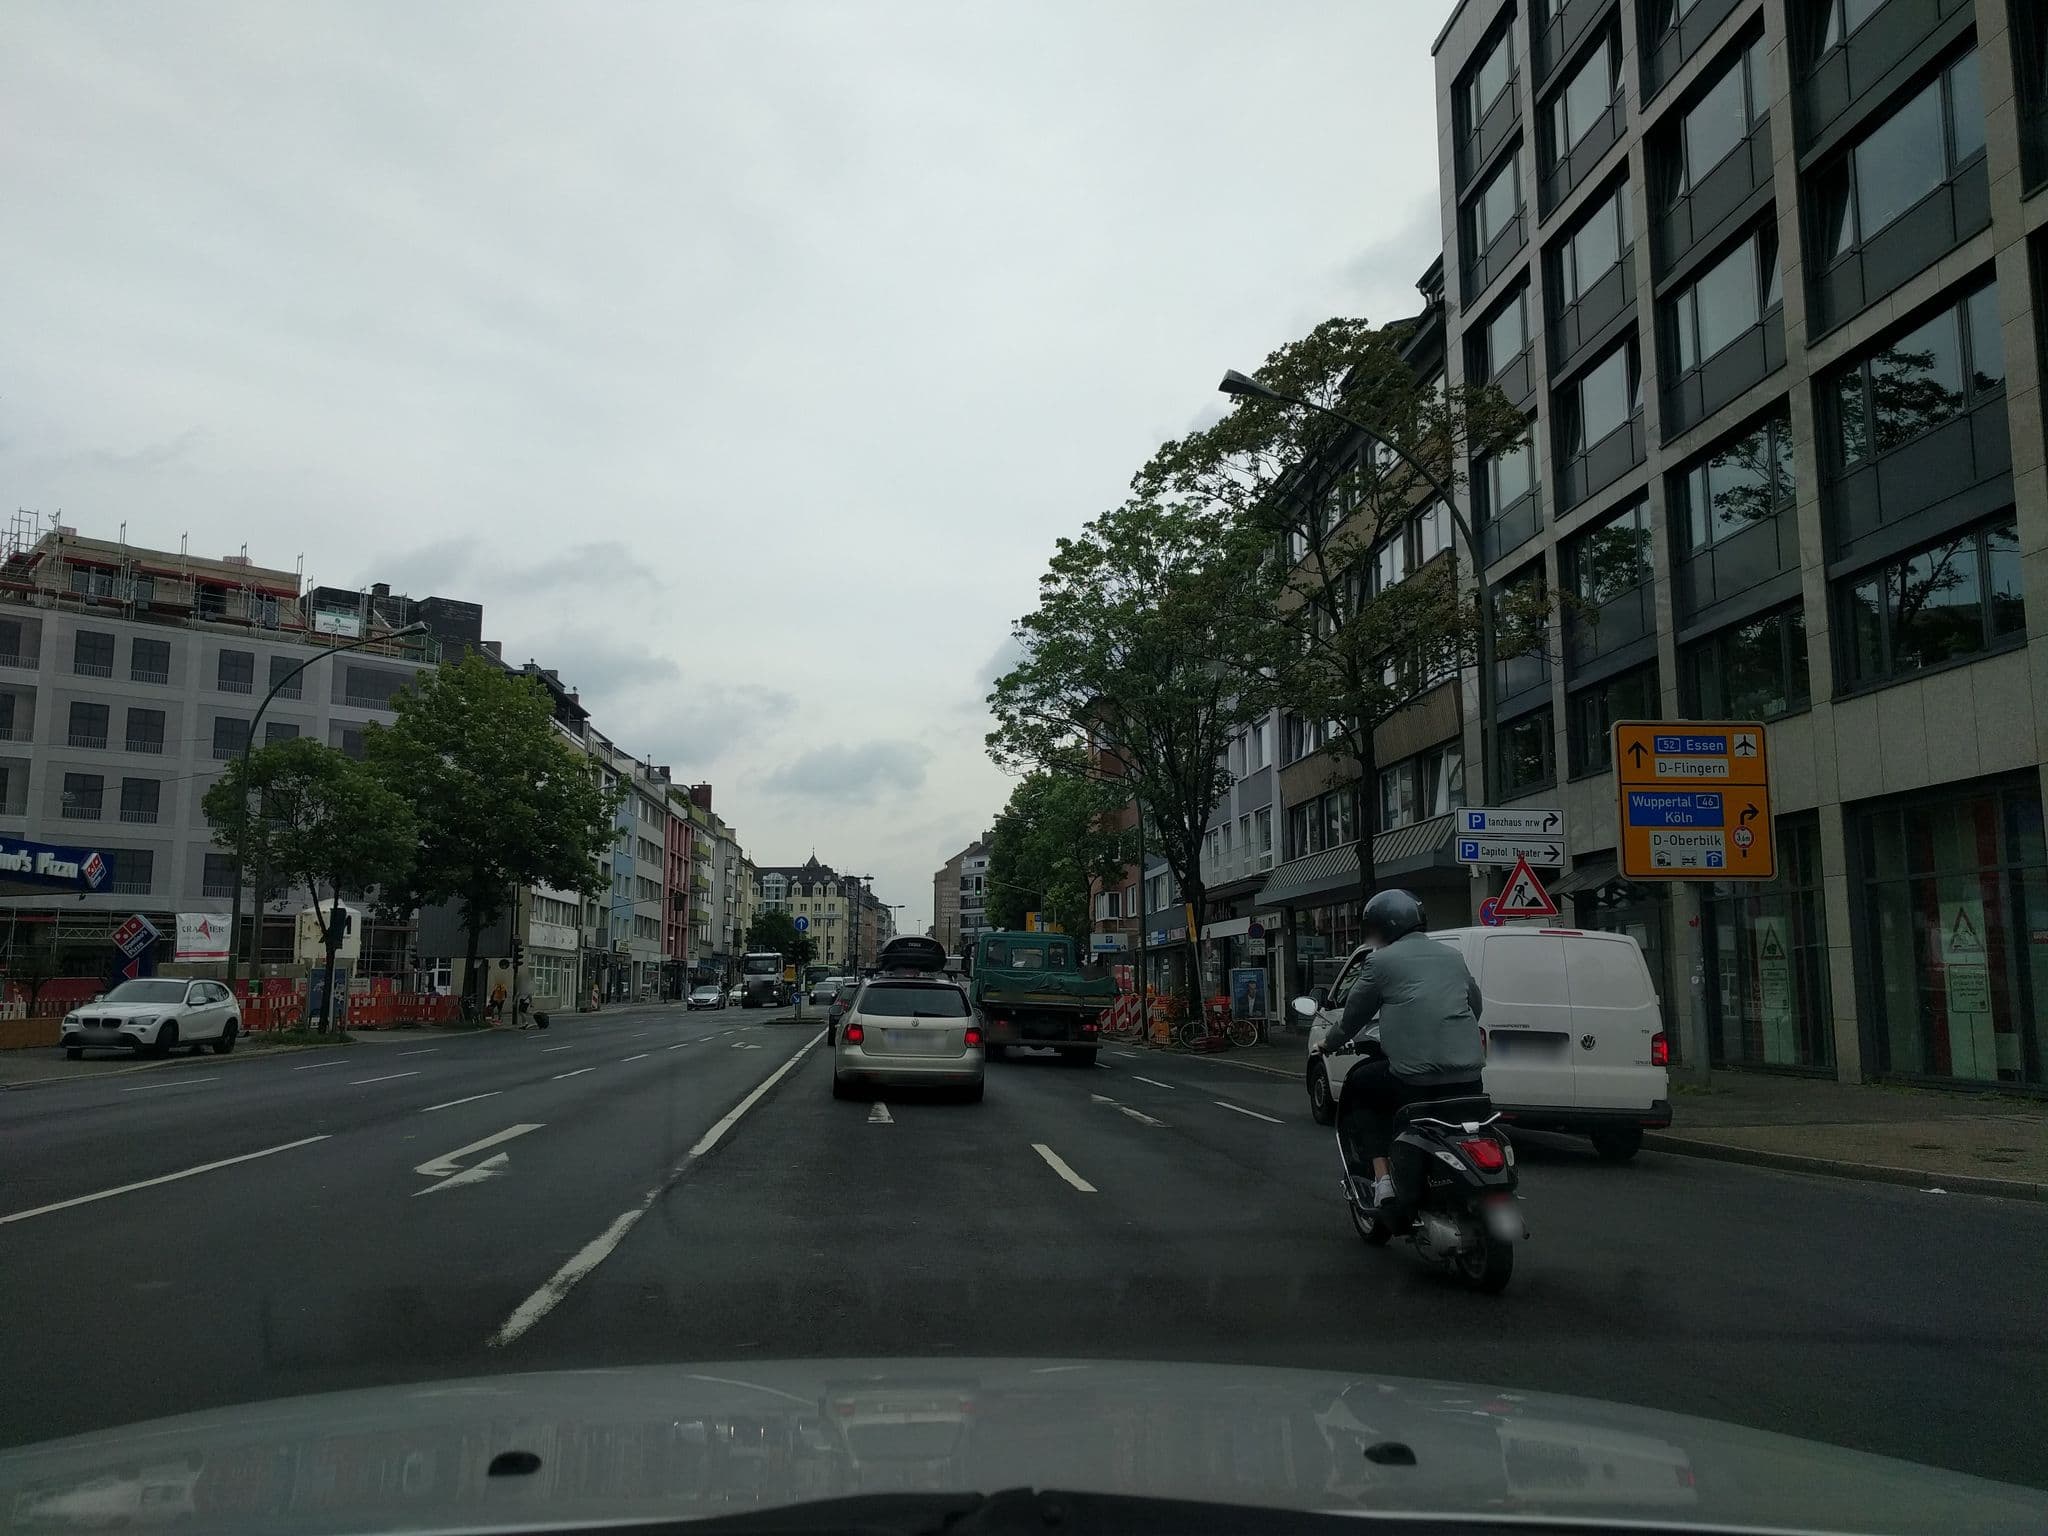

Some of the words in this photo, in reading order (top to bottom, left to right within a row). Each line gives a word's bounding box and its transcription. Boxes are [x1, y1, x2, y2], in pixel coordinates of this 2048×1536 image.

[1663, 740, 1675, 749] 52
[1686, 739, 1724, 751] Essen
[1658, 762, 1725, 776] D-Flingern
[1632, 795, 1692, 811] Wuppertal
[1702, 797, 1714, 806] 46
[1488, 817, 1522, 827] tanzhaus
[1525, 819, 1540, 827] nrw
[1665, 811, 1693, 824] Köln
[1653, 833, 1722, 846] D-Oberbilk
[1481, 846, 1508, 858] Capitol
